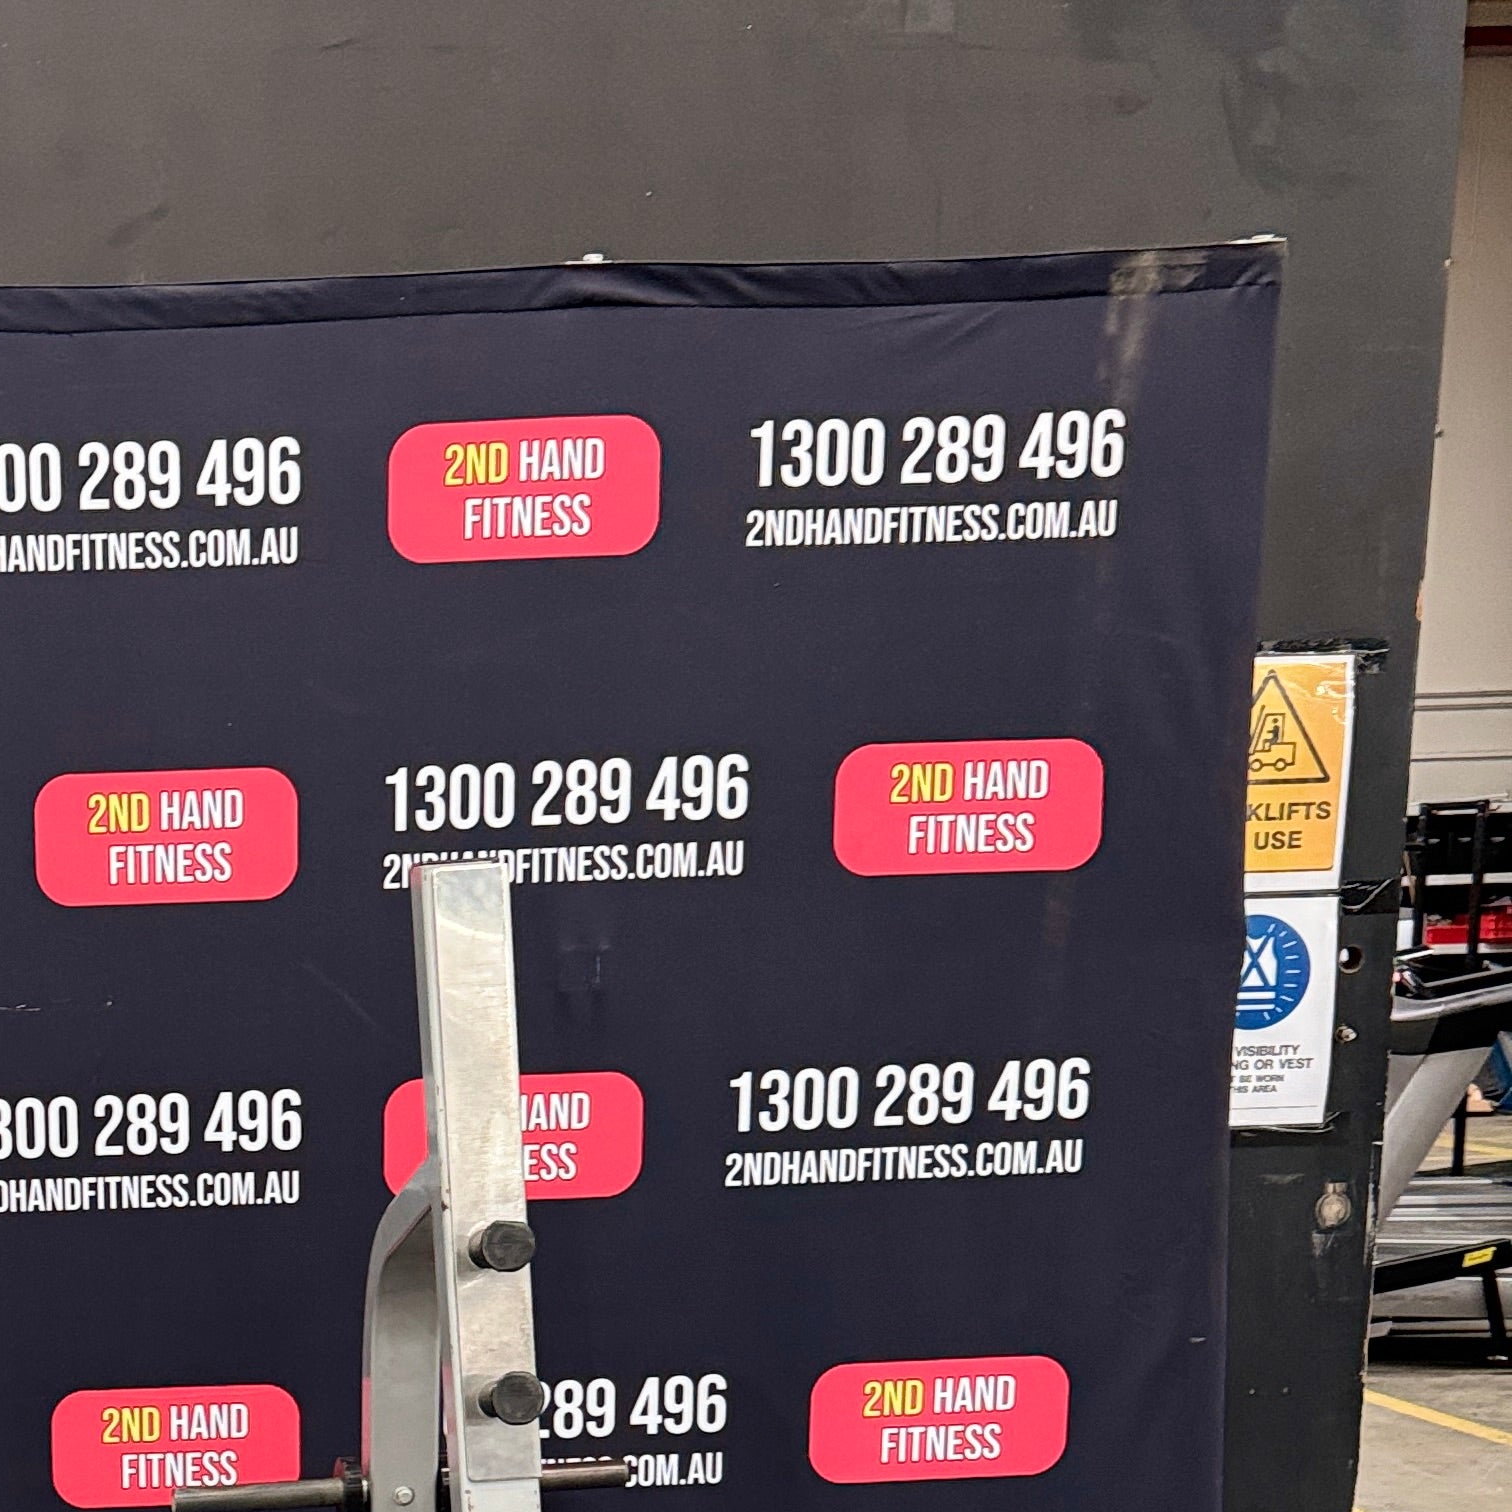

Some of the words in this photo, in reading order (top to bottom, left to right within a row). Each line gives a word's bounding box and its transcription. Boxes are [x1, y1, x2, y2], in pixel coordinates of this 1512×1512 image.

[444, 442, 509, 486] 2ND
[519, 437, 605, 482] HAND
[750, 417, 886, 488] 1300
[900, 413, 1006, 484] 289
[1018, 408, 1126, 480] 496
[78, 440, 181, 511] 289
[196, 435, 301, 507] 496
[464, 493, 591, 540] FITNESS
[745, 499, 1118, 547] 2NDHANDFITNESS.COM.AU
[385, 762, 516, 832] 1300
[530, 757, 632, 826] 289
[645, 753, 749, 821] 496
[890, 763, 954, 803] 2ND
[963, 760, 1049, 801] HAND
[88, 793, 150, 833] 2ND
[160, 789, 243, 831] HAND
[1248, 801, 1331, 821] KLIFTS
[908, 812, 1035, 854] FITNESS
[1254, 831, 1302, 850] USE
[109, 842, 232, 885] FITNESS
[383, 840, 744, 890] 2NDFITNESS.COM.AU
[1235, 1045, 1300, 1056] VISIBILITY
[1254, 1059, 1274, 1070] OR
[1279, 1058, 1314, 1069] VEST
[729, 1066, 859, 1133] 1300
[873, 1061, 975, 1127] 289
[987, 1057, 1091, 1121] 496
[1233, 1085, 1249, 1093] HIS
[1252, 1085, 1277, 1093] AREA
[94, 1092, 190, 1157] 289
[204, 1088, 302, 1152] 496
[724, 1138, 1083, 1187] 2NDHANDFITNESS.COM.AU
[629, 1373, 727, 1435] 496
[863, 1379, 924, 1417] 2ND
[933, 1375, 1016, 1414] HAND
[102, 1406, 160, 1443] 2ND
[170, 1403, 249, 1441] HAND
[881, 1423, 1002, 1463] FITNESS
[120, 1450, 238, 1490] FITNESS
